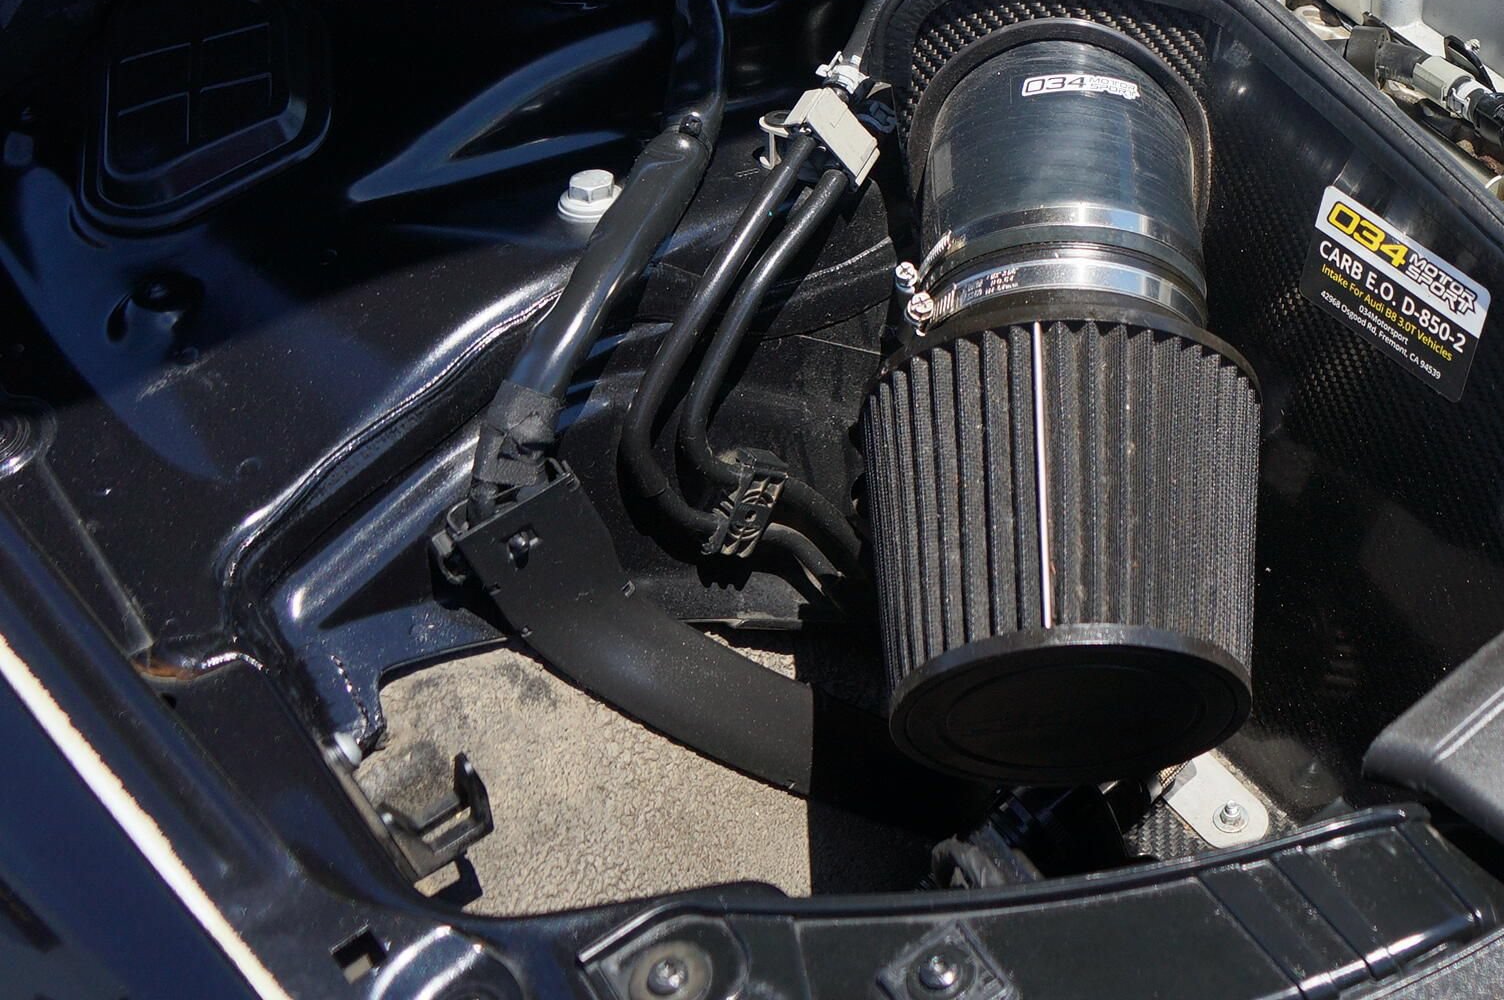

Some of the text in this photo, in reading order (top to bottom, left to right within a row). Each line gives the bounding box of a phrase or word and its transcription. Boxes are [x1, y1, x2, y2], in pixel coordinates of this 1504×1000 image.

[1025, 76, 1086, 94] 034
[1326, 200, 1409, 268] 034
[1319, 240, 1467, 354] CARB E.O. D-850-2
[1405, 265, 1475, 315] SPORT
[1408, 252, 1477, 308] MOTOR
[1320, 290, 1441, 380] 42968 Osgood Rd, Fremont, CA 94539
[1321, 263, 1453, 362] Intake For Audi B8 3.0T Vehicles
[1358, 305, 1409, 345] 034Motorsport
